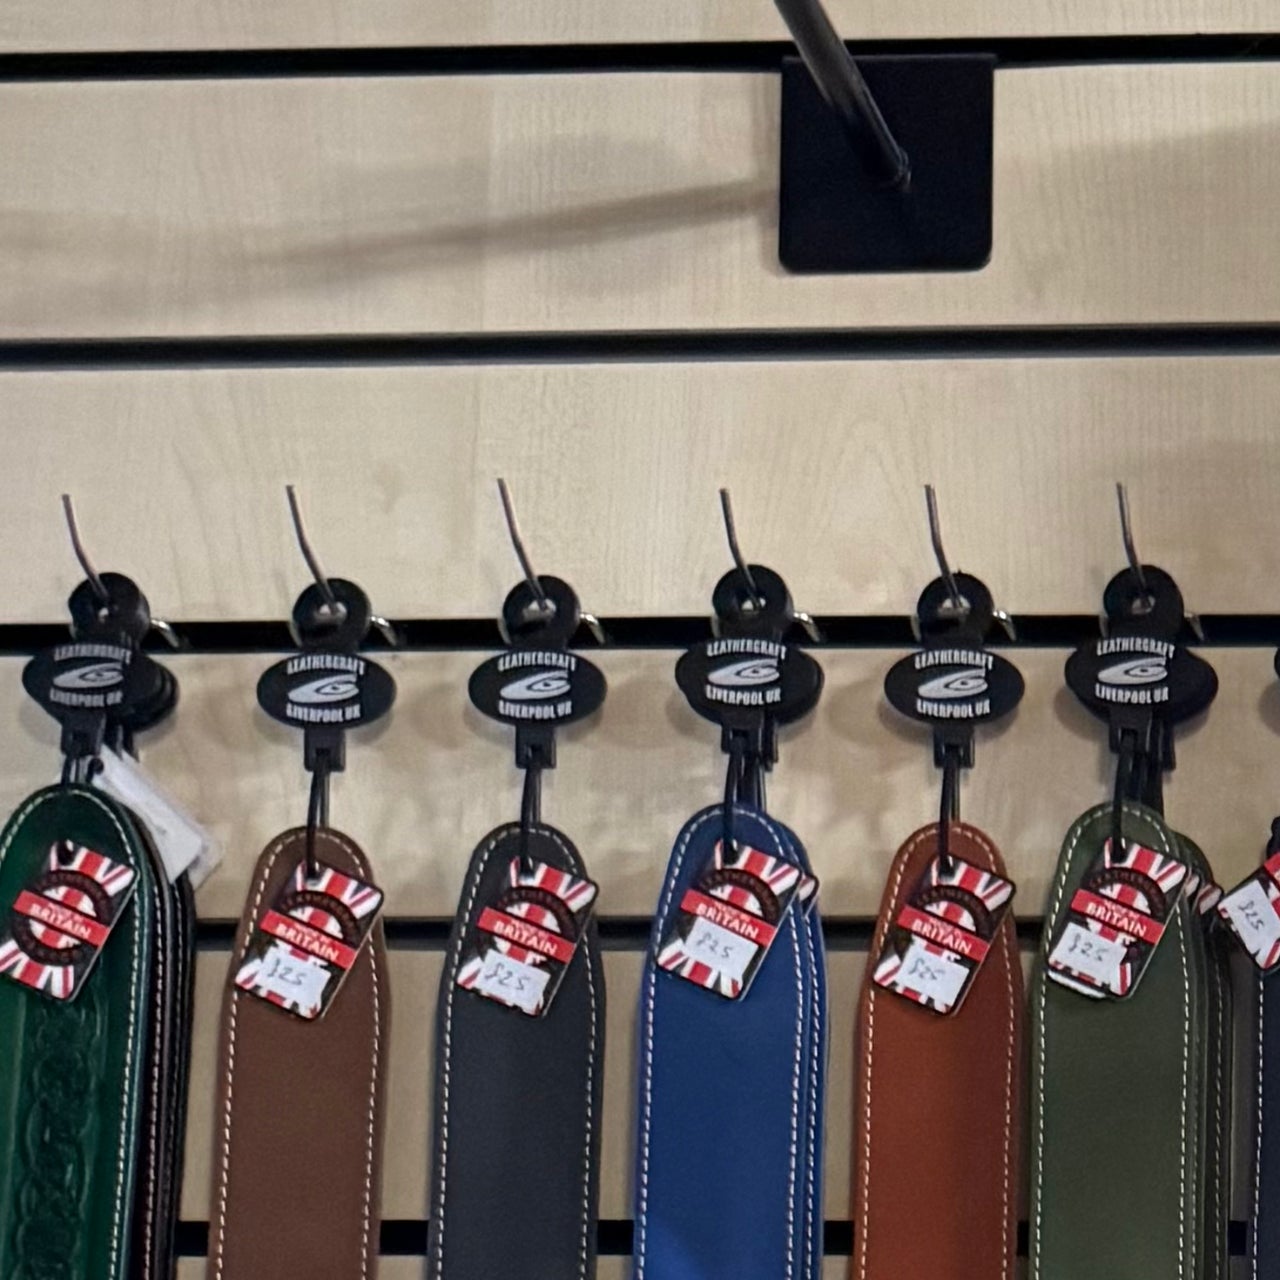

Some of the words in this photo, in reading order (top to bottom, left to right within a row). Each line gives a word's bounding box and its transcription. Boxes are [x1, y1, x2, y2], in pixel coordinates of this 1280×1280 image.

[498, 700, 556, 720] LIVERPOOL
[557, 700, 572, 717] UK
[705, 684, 764, 705] LIVERPOOL
[766, 688, 781, 702] UK
[917, 698, 974, 718] LIVERPOOL
[975, 698, 990, 715] UK
[1095, 683, 1152, 704] LIVERPOOL
[1154, 687, 1169, 702] UK
[286, 703, 343, 723] LIVERPOOL
[346, 705, 361, 720] UK
[28, 903, 92, 937] BRITAIN
[696, 903, 760, 938] BRITAIN
[911, 919, 972, 954] BRITAIN
[1086, 902, 1147, 937] BRITAIN
[276, 923, 339, 960] BRITAIN
[494, 921, 558, 955] BRITAIN
